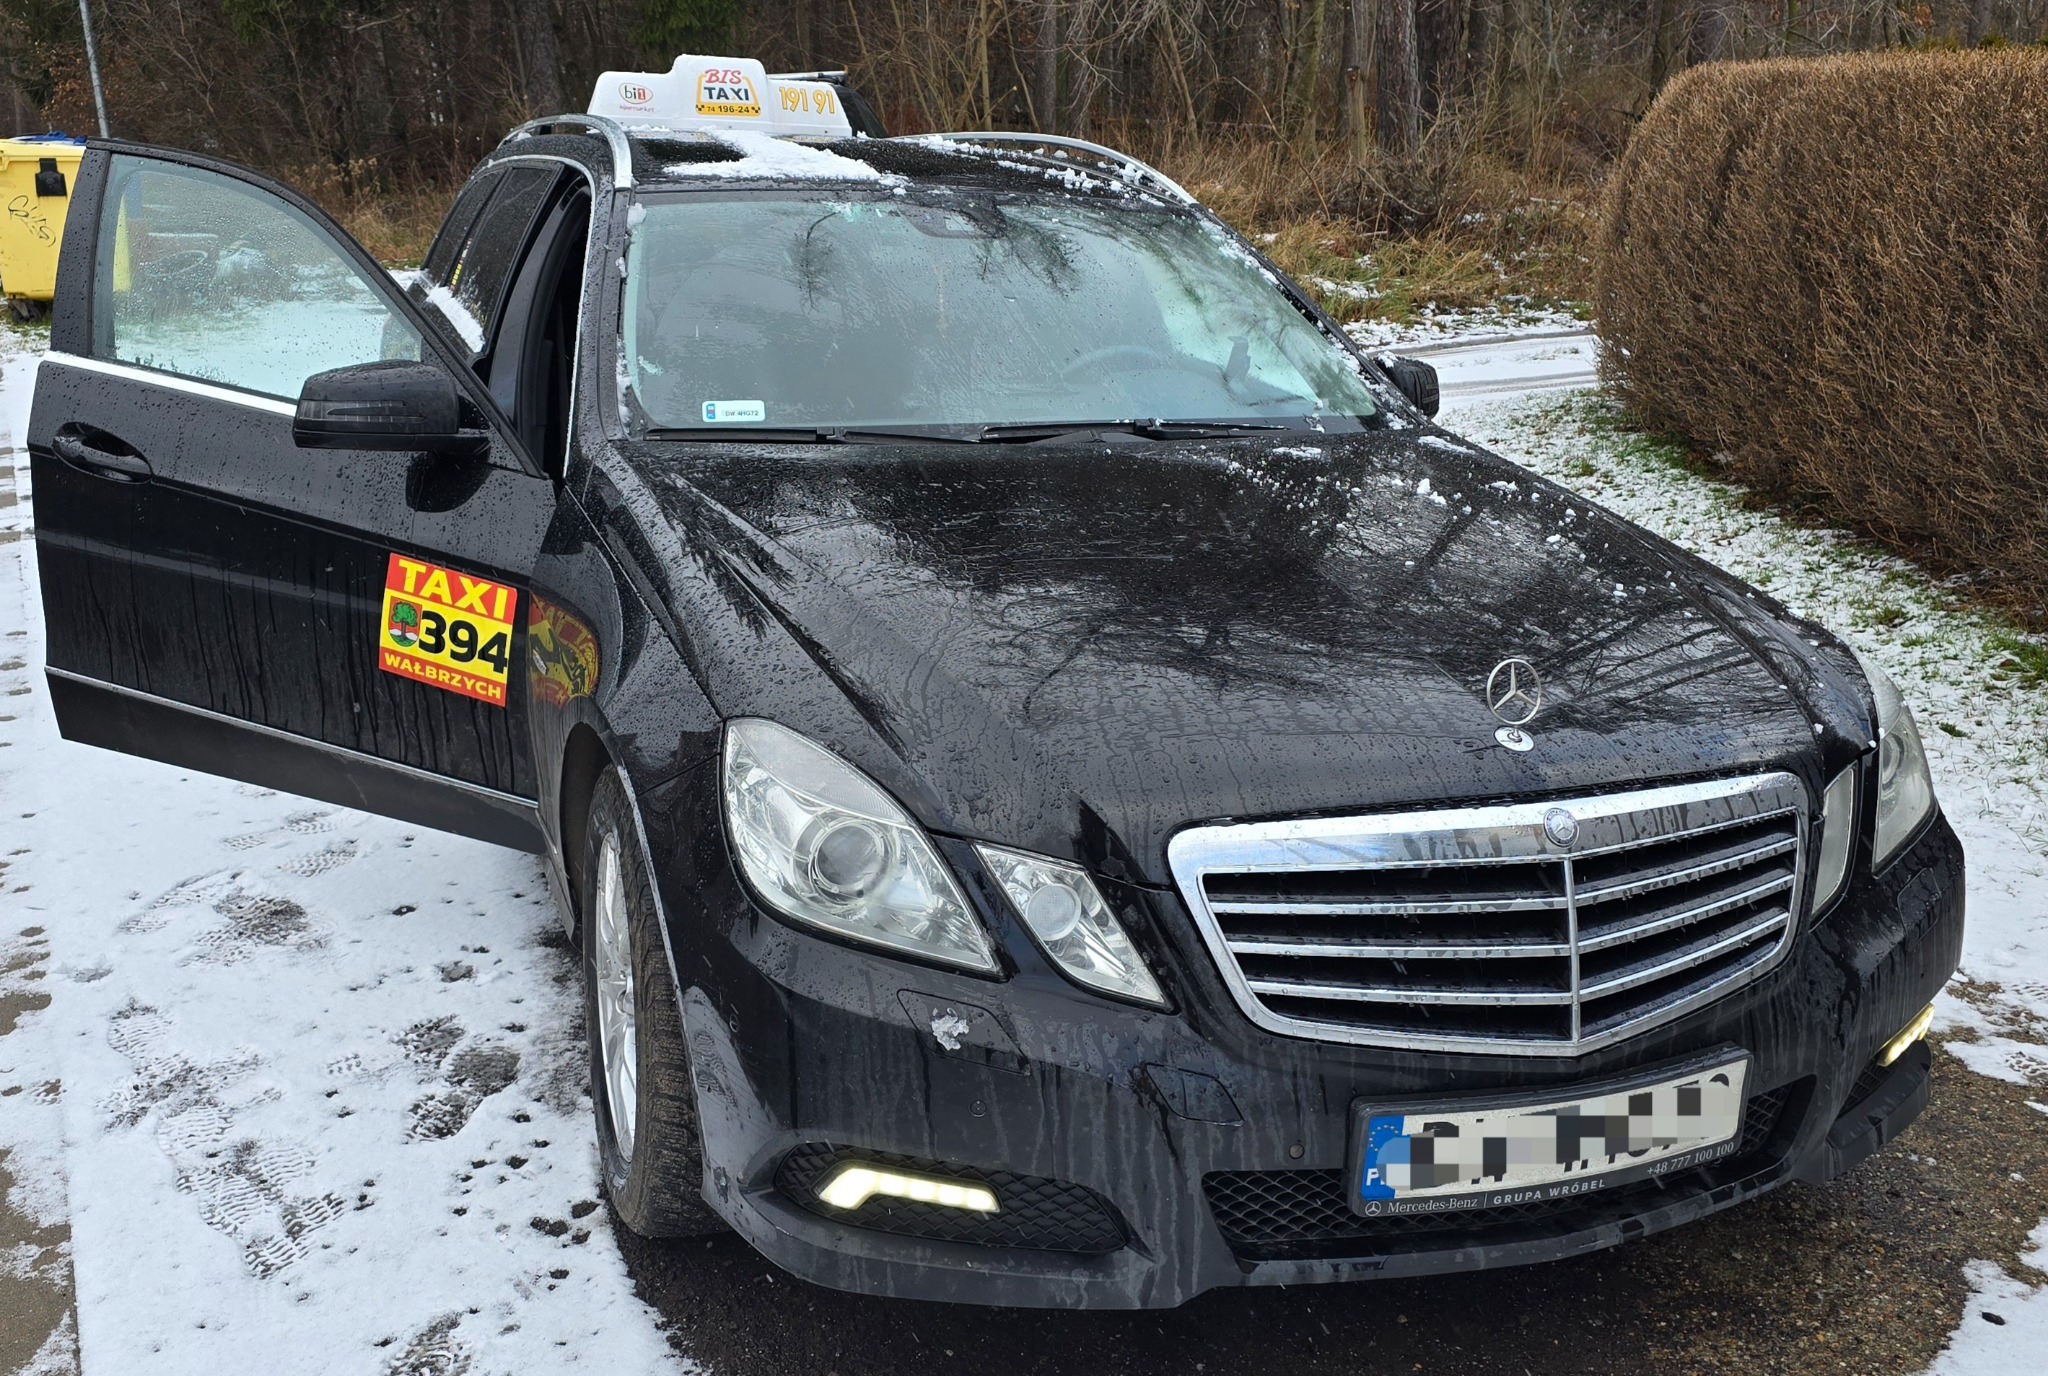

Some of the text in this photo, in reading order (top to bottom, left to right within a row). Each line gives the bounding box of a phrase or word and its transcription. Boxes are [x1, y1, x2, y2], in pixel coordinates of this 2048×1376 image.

[704, 69, 742, 84] BIS
[703, 86, 749, 101] TAXI
[718, 105, 750, 113] 196-24
[779, 86, 835, 114] 191 91
[398, 558, 508, 620] TAXI
[418, 609, 508, 675] 394
[384, 652, 502, 700] WAŁBRZYCH
[1647, 1142, 1735, 1175] +48 777 100 100
[1387, 1179, 1606, 1213] Mercedes-Benz GRUPA WRÓBEL
